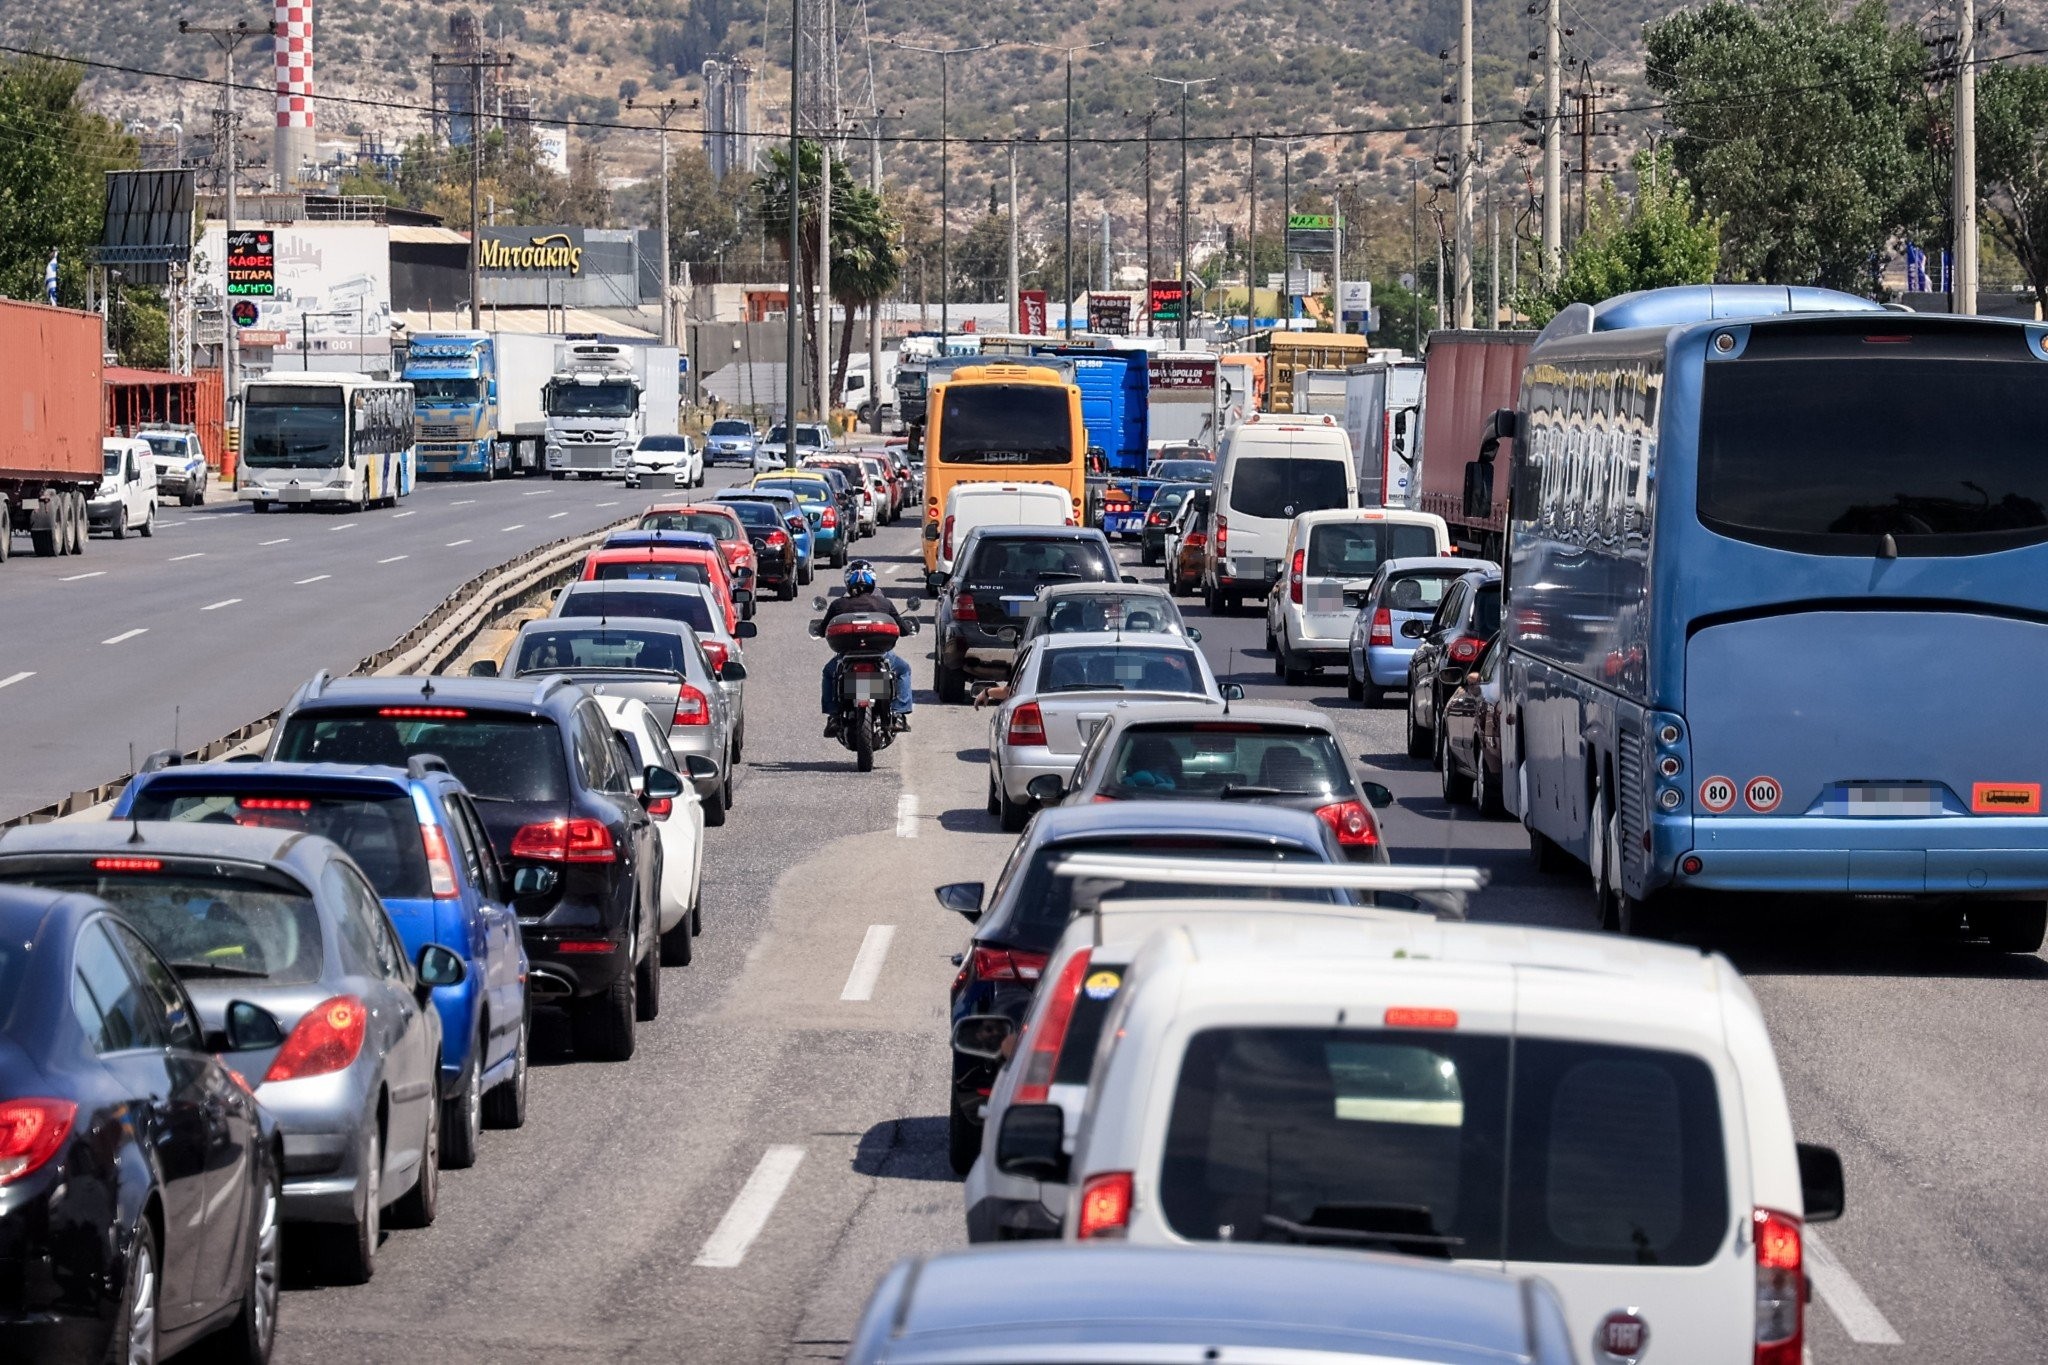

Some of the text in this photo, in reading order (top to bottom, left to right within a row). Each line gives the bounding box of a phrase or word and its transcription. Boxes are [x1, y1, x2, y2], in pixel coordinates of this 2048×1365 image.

[228, 233, 255, 246] coffee
[228, 256, 273, 266] ΚΑΦΕΣ
[228, 270, 273, 280] ΤΣΙΓΑΡΑ
[228, 284, 273, 293] ΦΑΓΗΤΟ
[1091, 299, 1130, 308] ΚΑΦΕΣ
[236, 303, 254, 316] 24
[984, 451, 1029, 462] ISUZU
[1710, 785, 1727, 800] 80
[1751, 786, 1775, 801] 100
